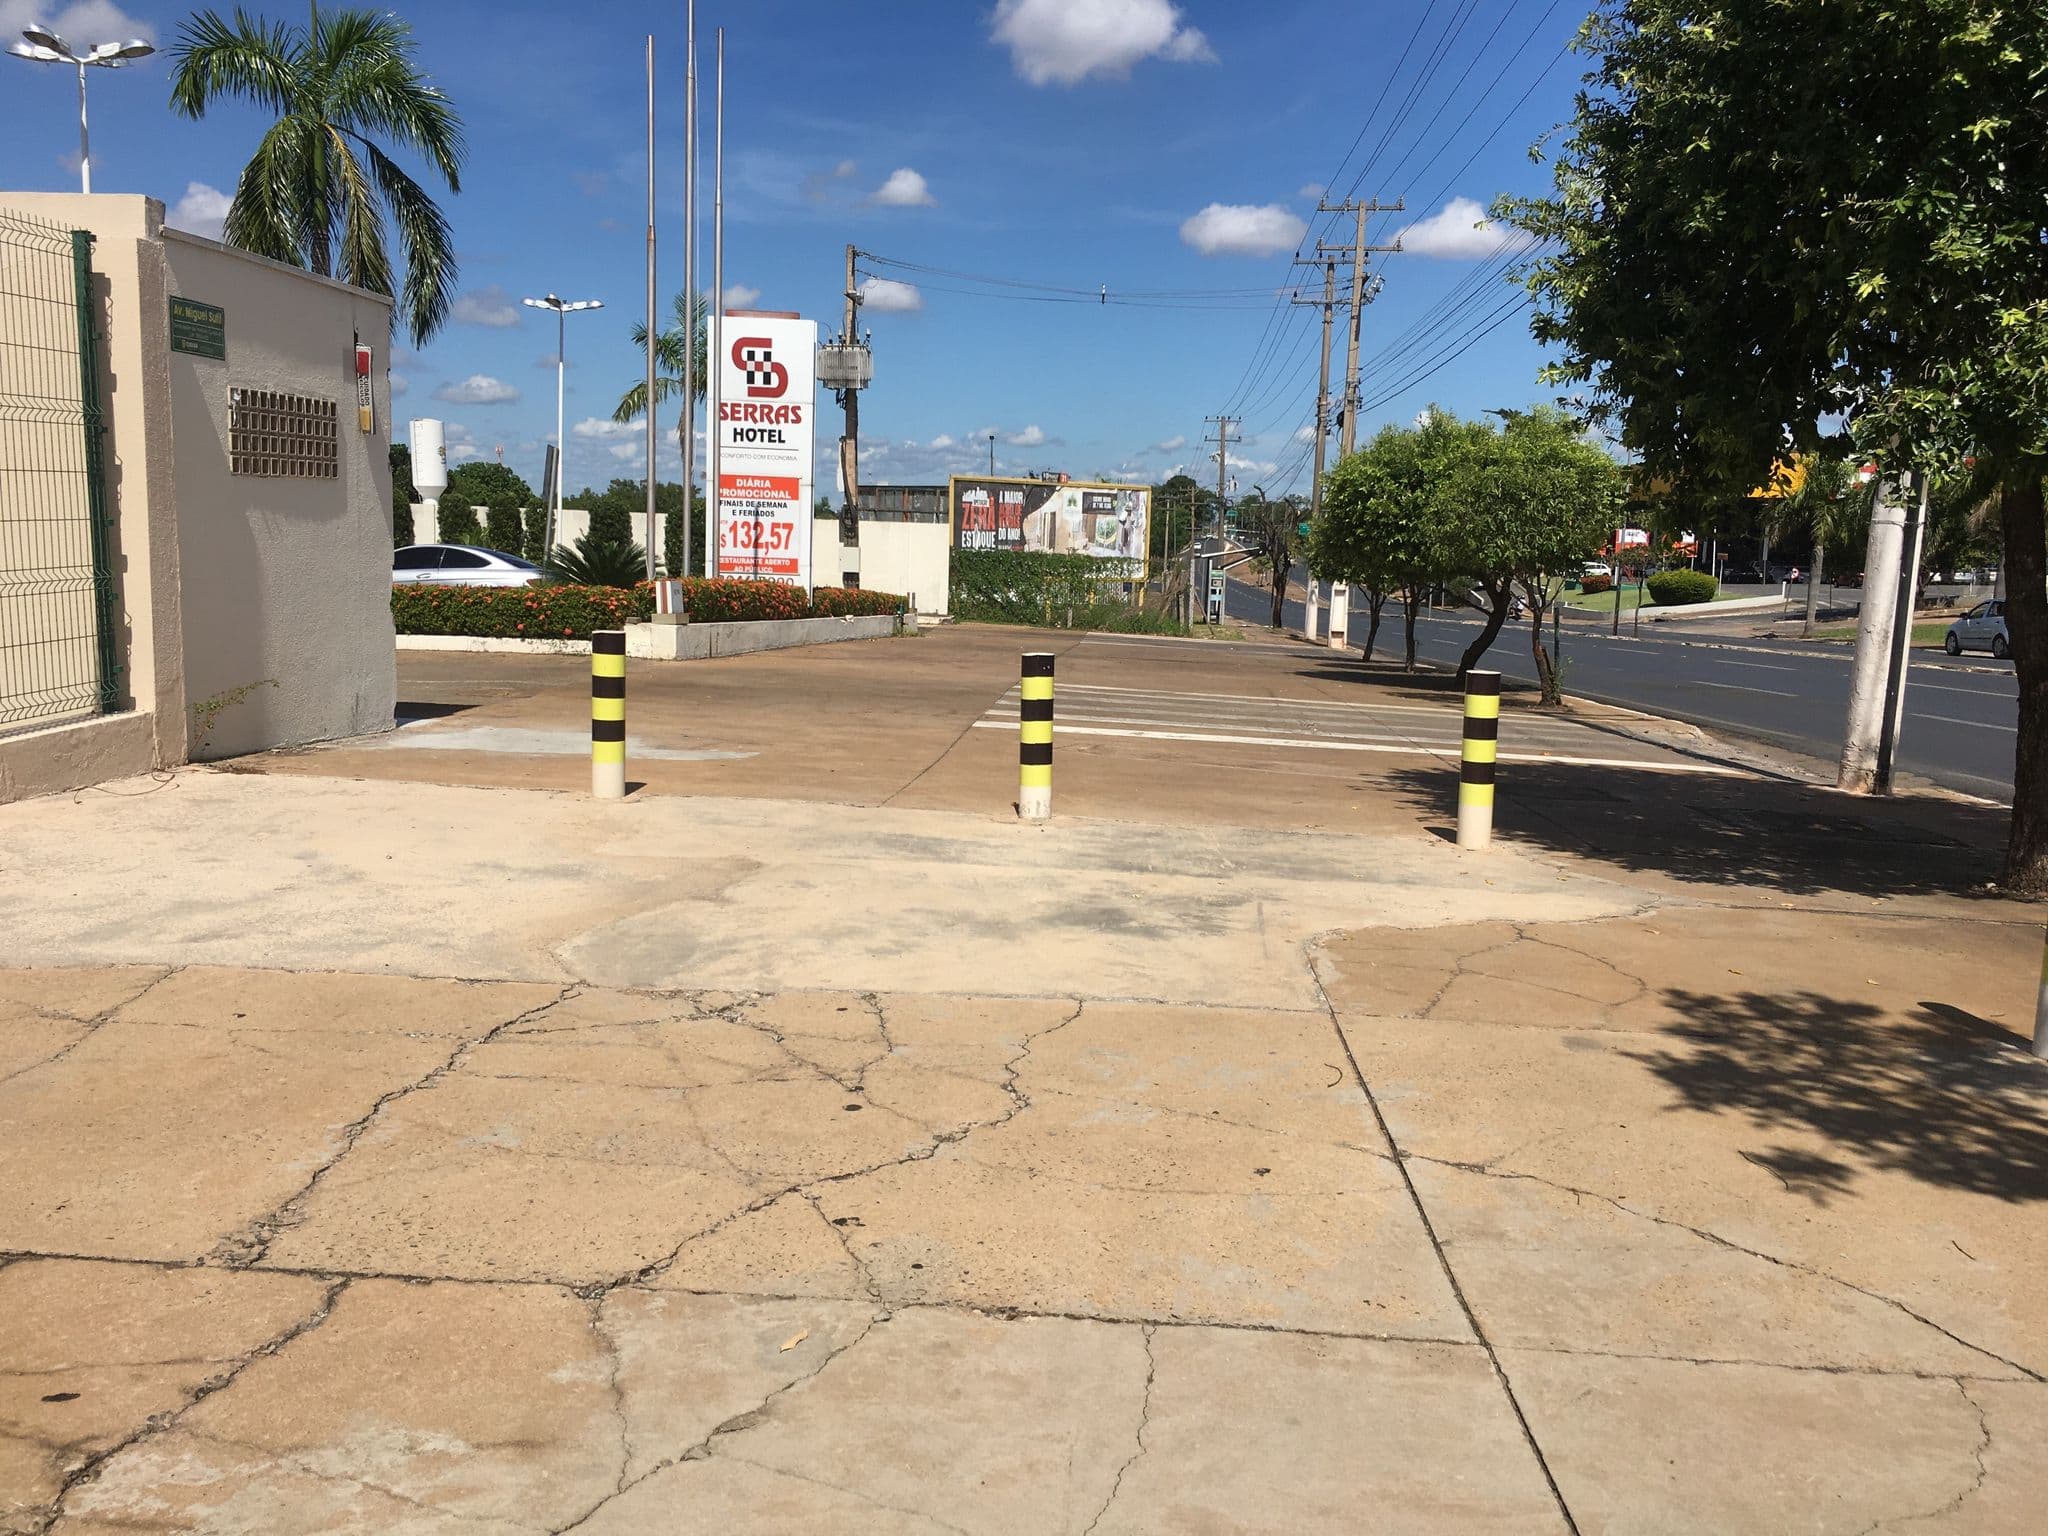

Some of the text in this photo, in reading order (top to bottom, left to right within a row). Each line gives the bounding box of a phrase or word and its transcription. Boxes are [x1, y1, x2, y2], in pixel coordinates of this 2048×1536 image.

[720, 402, 802, 425] SERRAS
[733, 427, 786, 443] HOTEL
[736, 478, 771, 488] DIÁRIA
[720, 499, 744, 507] FINAIS
[738, 509, 775, 517] FERIADOS
[729, 520, 794, 556] 132,57
[720, 557, 763, 565] ESTAURANTE
